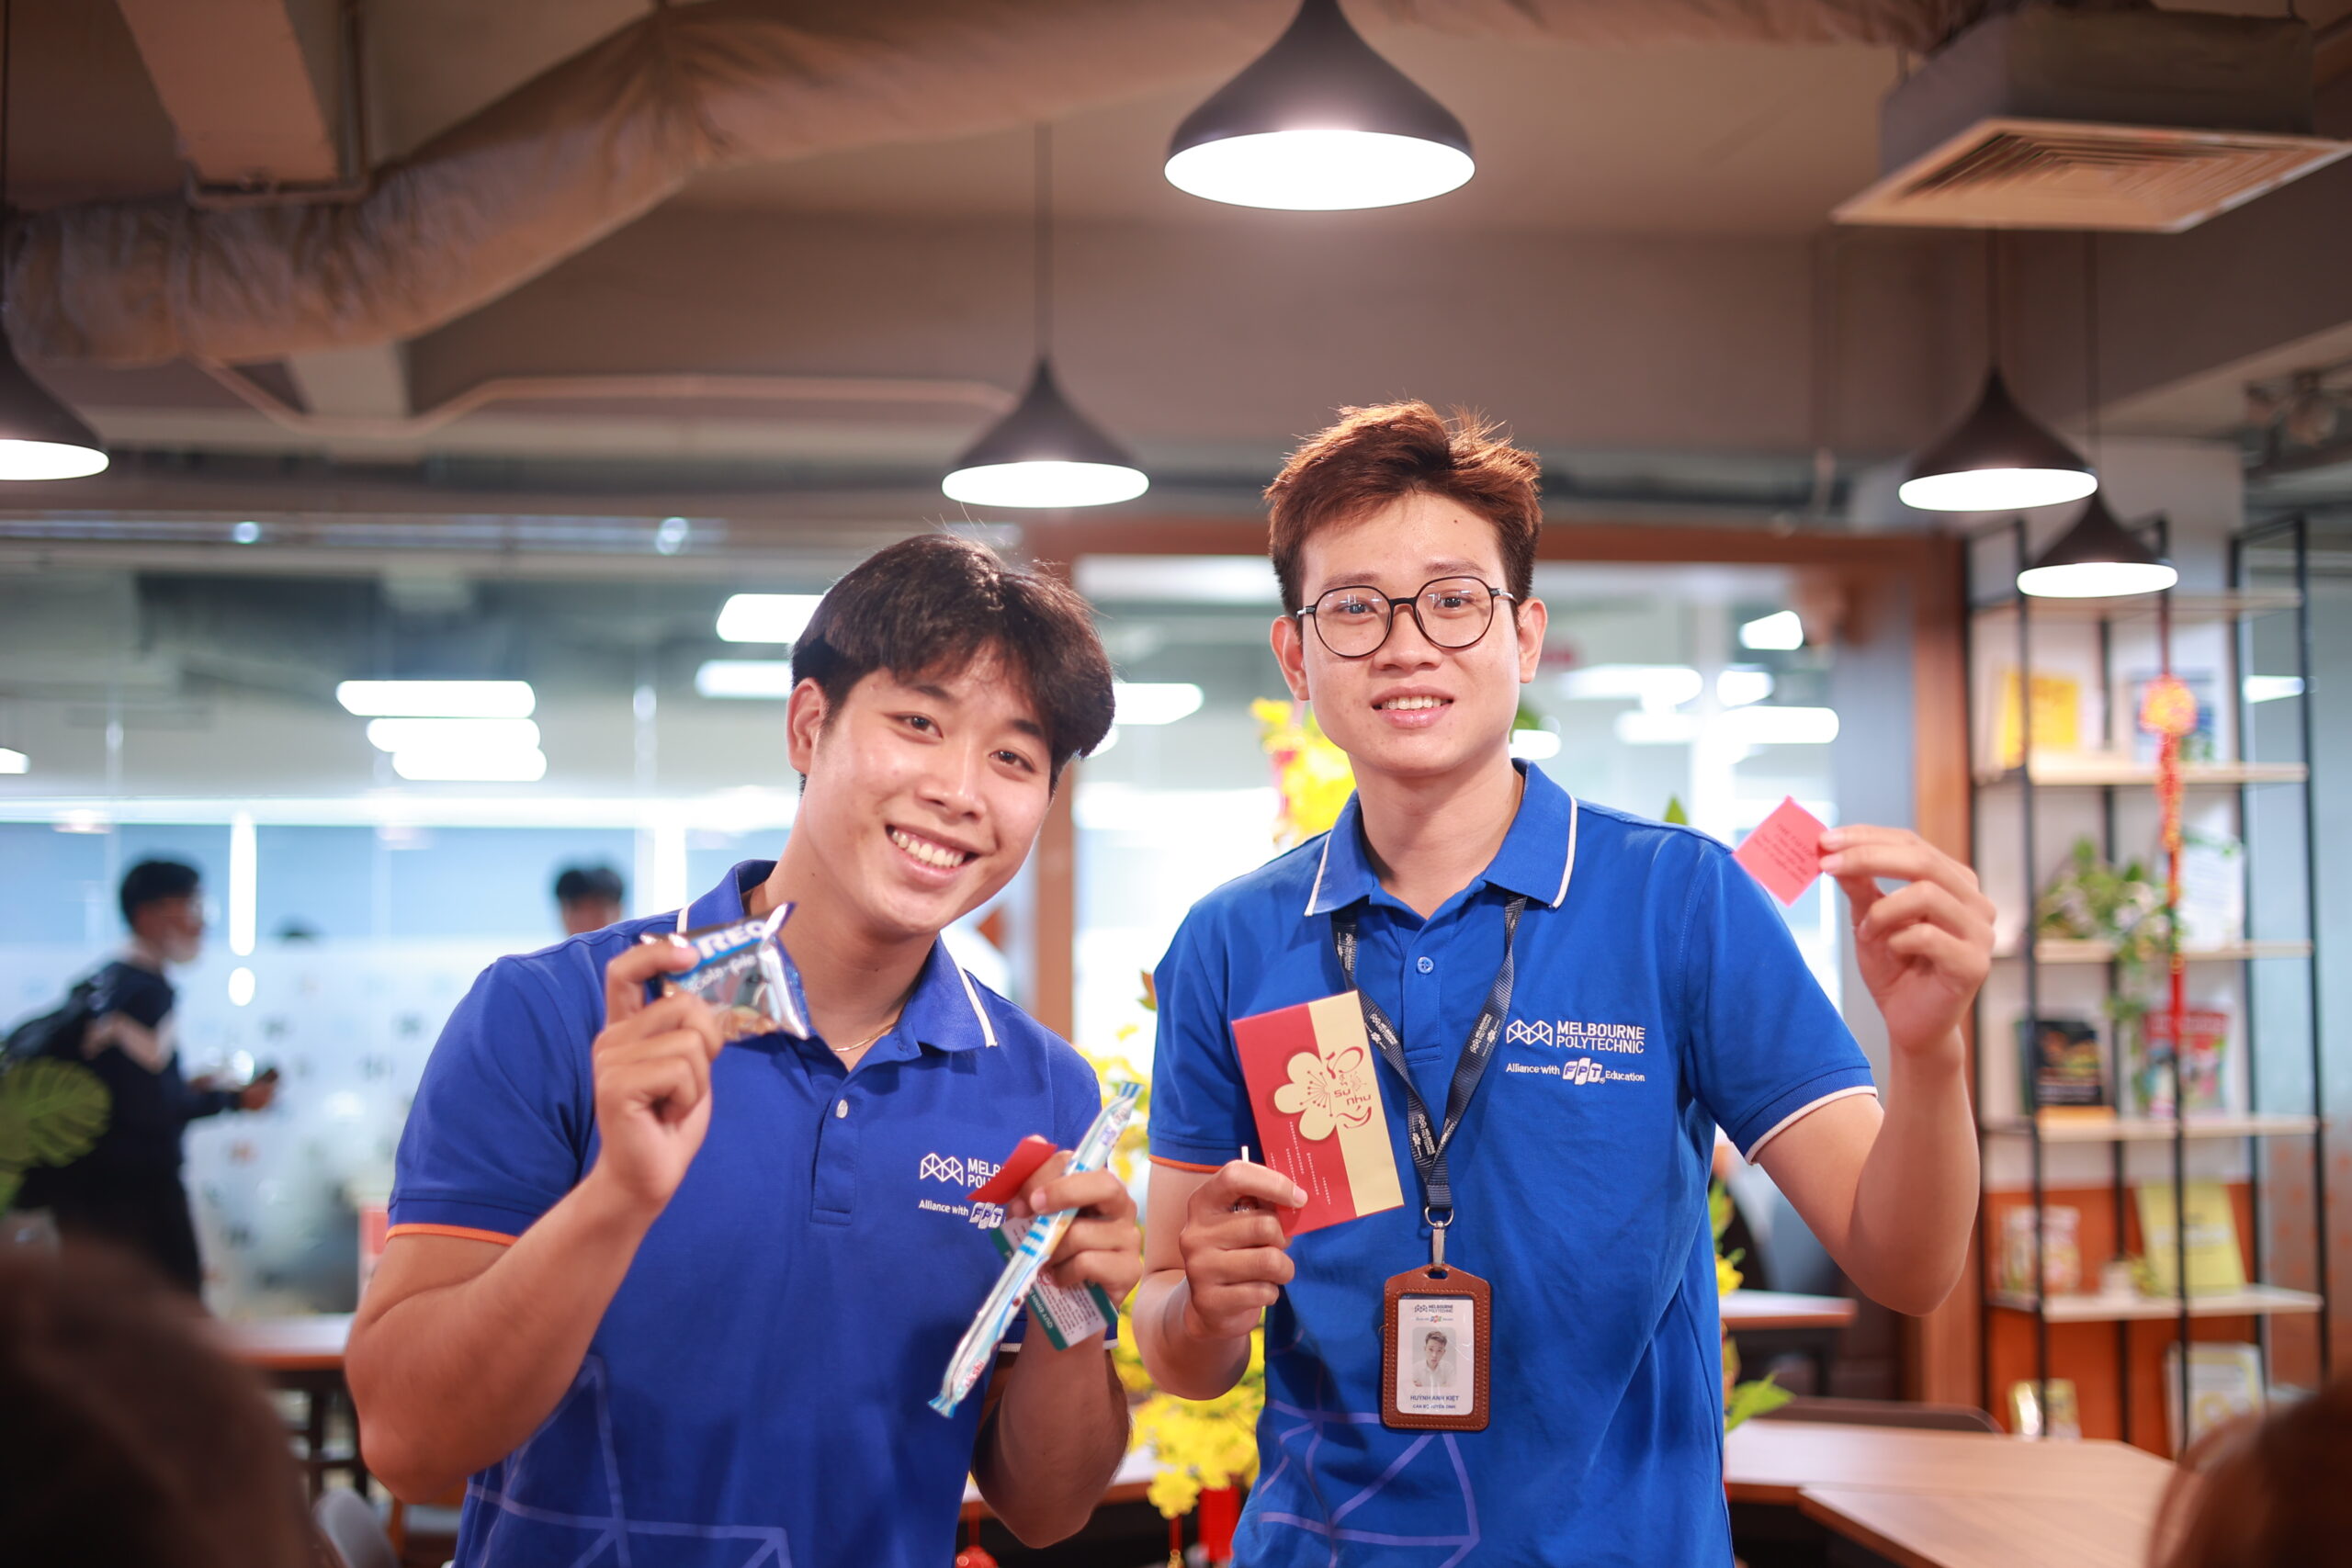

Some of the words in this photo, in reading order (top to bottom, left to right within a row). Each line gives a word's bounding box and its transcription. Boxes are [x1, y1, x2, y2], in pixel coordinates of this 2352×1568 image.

[697, 920, 766, 960] REO
[1556, 1020, 1646, 1040] MELBOURNE
[1556, 1035, 1645, 1054] POLYTECHNIC
[1506, 1063, 1539, 1074] Alliance
[1541, 1064, 1560, 1076] with
[1562, 1057, 1603, 1086] FPT
[1605, 1070, 1645, 1082] Education
[919, 1199, 951, 1213] Alliance
[952, 1205, 968, 1216] with
[969, 1202, 1004, 1229] FPT
